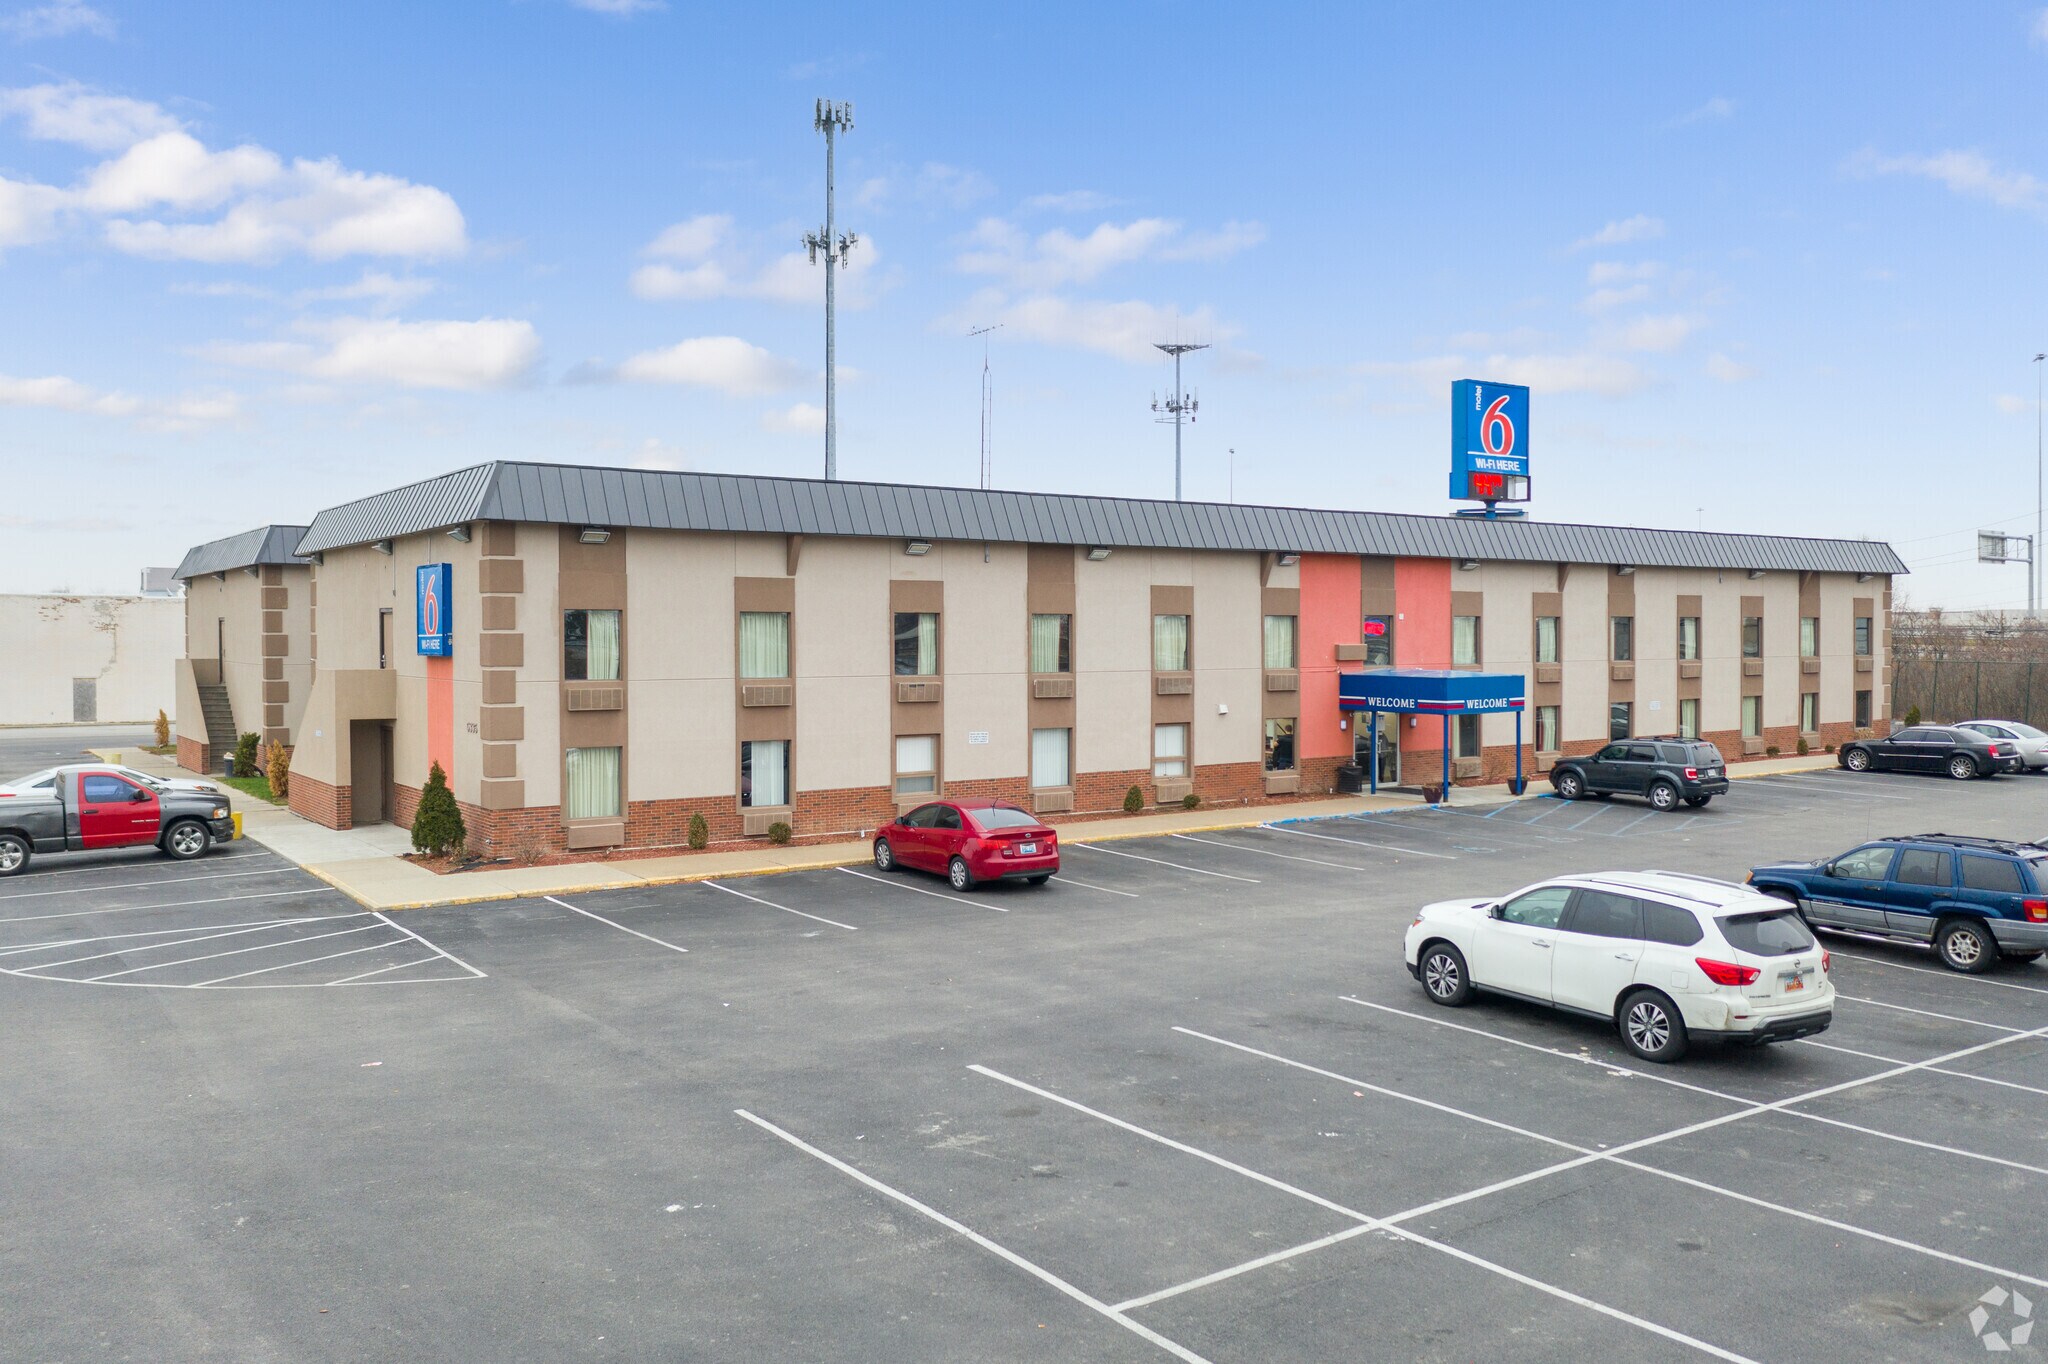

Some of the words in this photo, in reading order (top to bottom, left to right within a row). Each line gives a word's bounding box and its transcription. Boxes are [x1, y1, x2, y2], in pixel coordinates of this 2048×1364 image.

[1481, 395, 1514, 455] 6
[1475, 457, 1496, 469] WI-FI
[1496, 459, 1520, 471] HERE
[424, 574, 438, 635] 6
[1368, 696, 1415, 708] WELCOME
[1466, 698, 1507, 709] WELCOME
